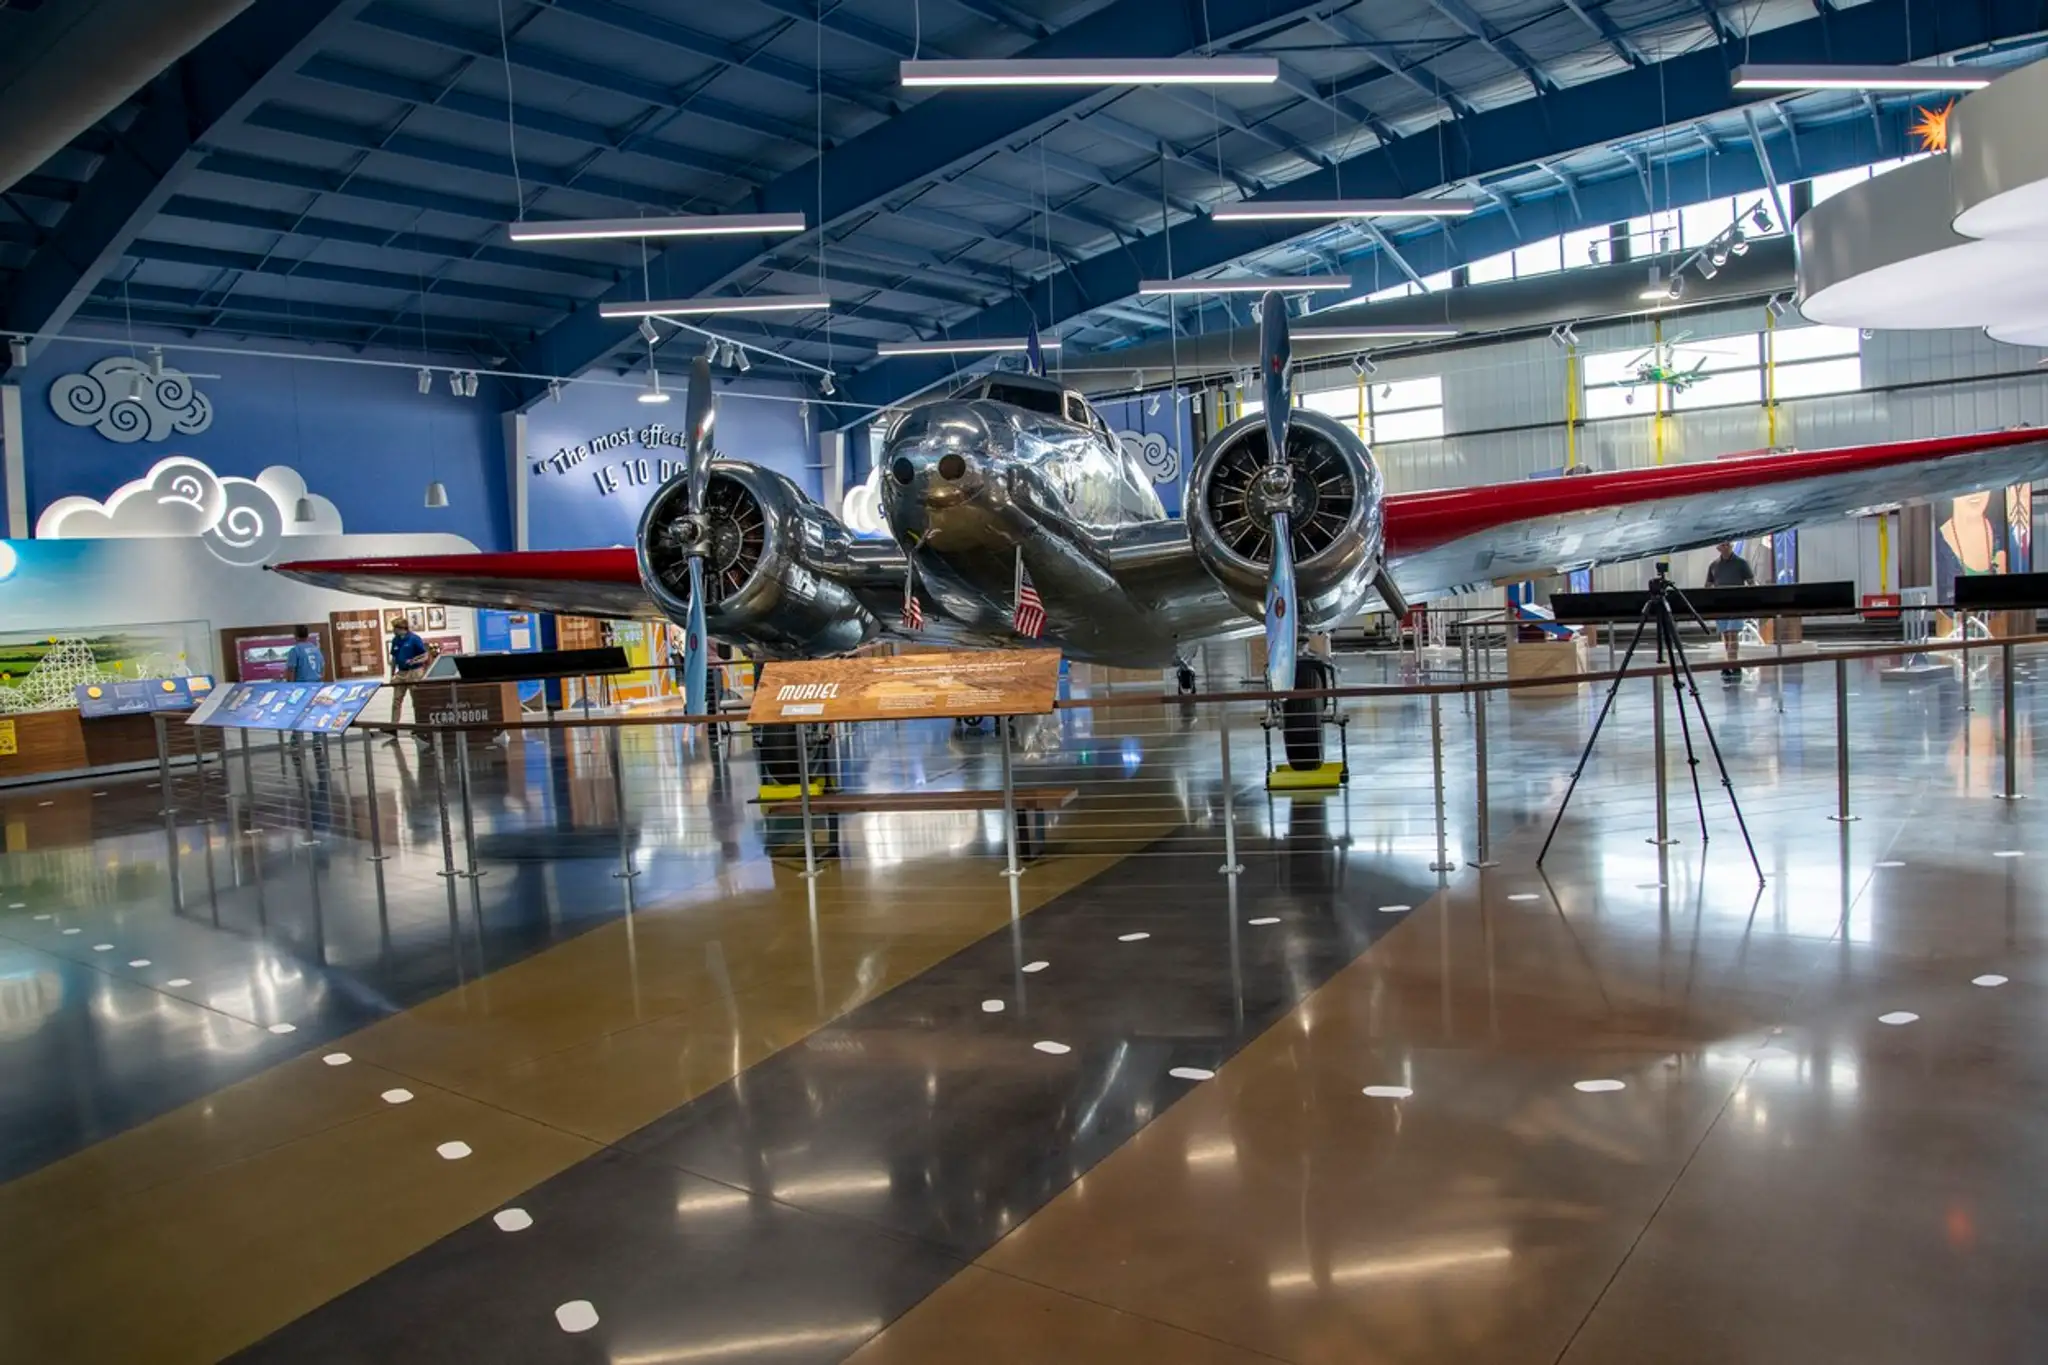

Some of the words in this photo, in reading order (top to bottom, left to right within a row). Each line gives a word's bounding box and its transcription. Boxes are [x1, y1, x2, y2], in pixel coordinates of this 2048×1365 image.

[592, 427, 635, 454] most
[640, 423, 688, 450] effect
[594, 465, 619, 495] IS
[623, 458, 649, 486] TO
[776, 683, 839, 700] MURIEL
